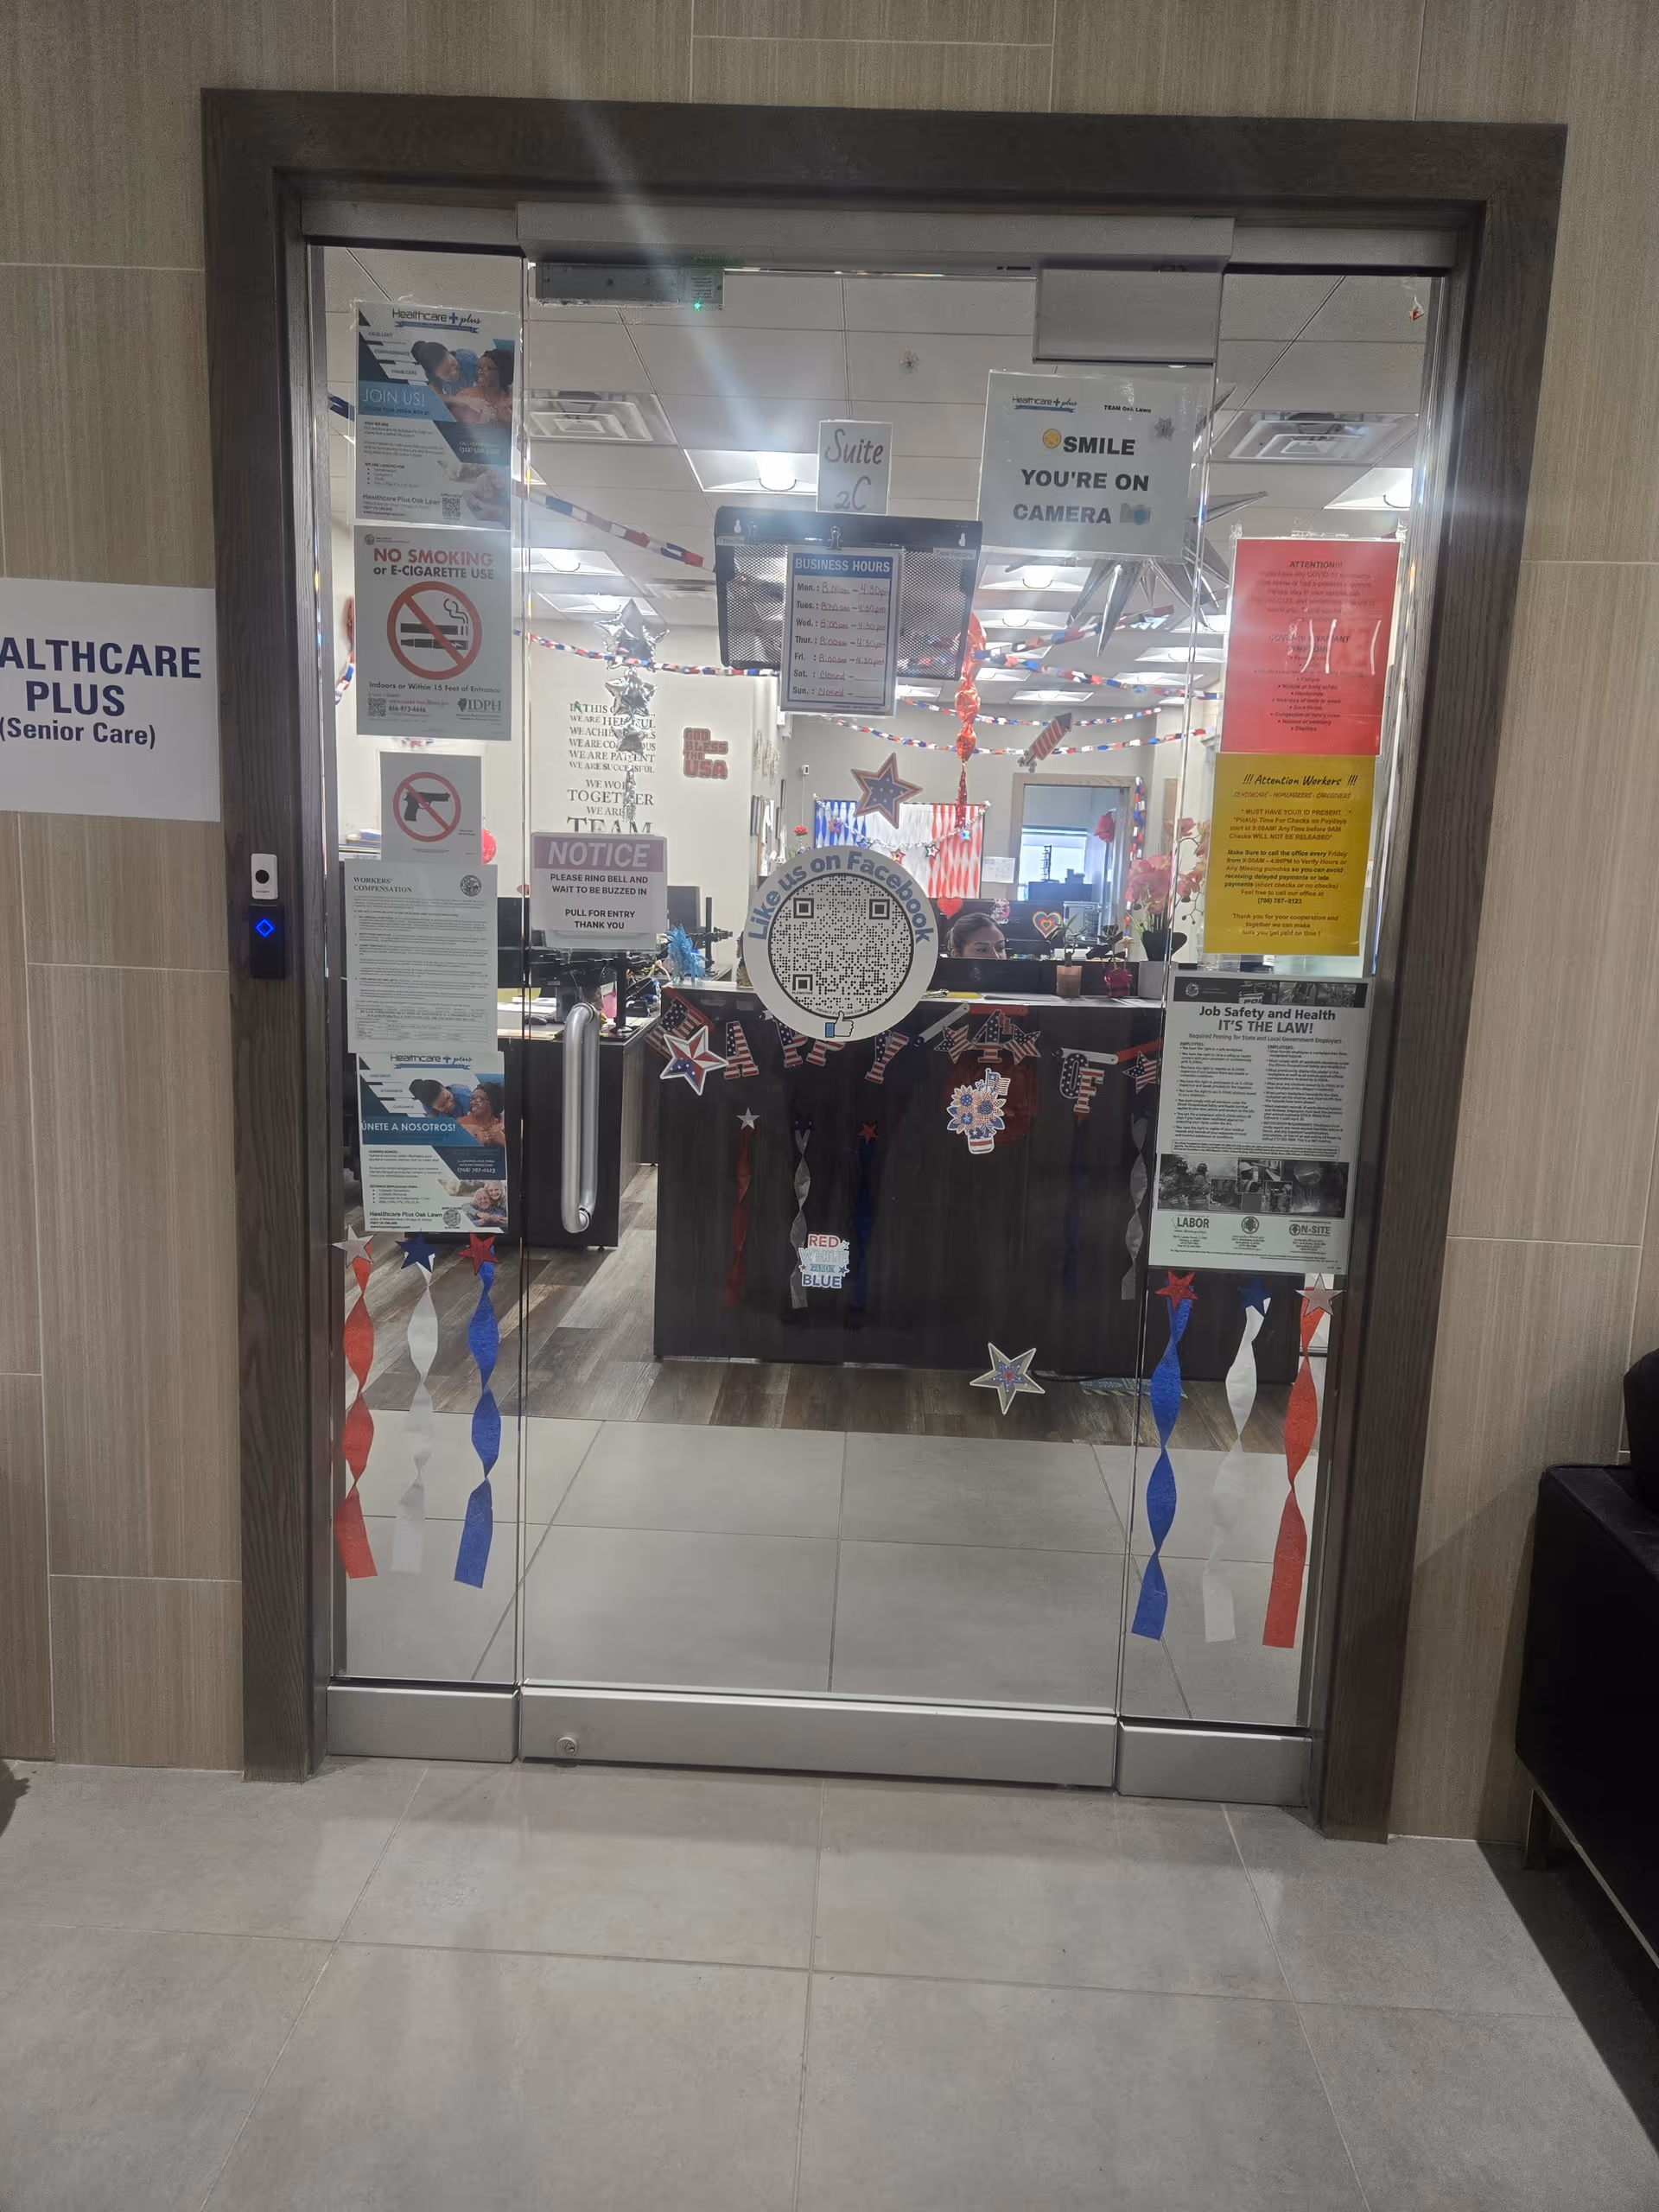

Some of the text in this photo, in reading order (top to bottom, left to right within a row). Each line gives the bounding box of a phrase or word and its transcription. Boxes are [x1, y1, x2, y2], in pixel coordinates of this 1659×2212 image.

[392, 308, 481, 326] Healthcare plus
[363, 389, 424, 406] JOIN US!
[1013, 395, 1077, 408] Healthcare plus
[825, 429, 883, 465] Suite
[1064, 436, 1135, 455] SMILE
[1021, 469, 1149, 491] YOU'RE ON
[363, 493, 396, 502] Healthcare
[834, 476, 871, 511] 2C
[1014, 504, 1111, 524] CAMERA
[374, 548, 493, 566] NO SMOKING
[391, 565, 466, 578] E-CIGARETTE
[472, 569, 493, 579] USE
[795, 558, 890, 572] BUSINESS HOURS
[0, 637, 201, 678] ALTHCARE
[818, 670, 845, 680] Closed
[26, 681, 124, 716] PLUS
[817, 688, 843, 696] Closed
[468, 700, 501, 711] IDPH
[583, 704, 607, 713] THIS
[0, 716, 156, 749] (Senior Care)
[569, 727, 584, 735] WE
[569, 738, 601, 747] WE ARE
[685, 741, 726, 753] BLESS
[569, 750, 608, 760] WE ARE
[685, 760, 726, 776] USA
[586, 779, 602, 788] WE
[1243, 774, 1357, 785] !!! Attention Workers !!!
[567, 790, 654, 805] TOGETER
[587, 806, 603, 815] WE
[567, 817, 652, 833] TEAM
[548, 842, 650, 868] NOTICE
[748, 851, 934, 944] Like us on Facebook
[1199, 1006, 1220, 1016] Job
[1224, 1007, 1264, 1020] Safety
[1295, 1009, 1336, 1020] Health
[1218, 1020, 1313, 1033] IT'S THE LAW!
[1177, 1217, 1209, 1228] LABOR
[809, 1236, 839, 1248] RED
[800, 1249, 849, 1262] WHITE
[803, 1274, 841, 1287] BLUE
